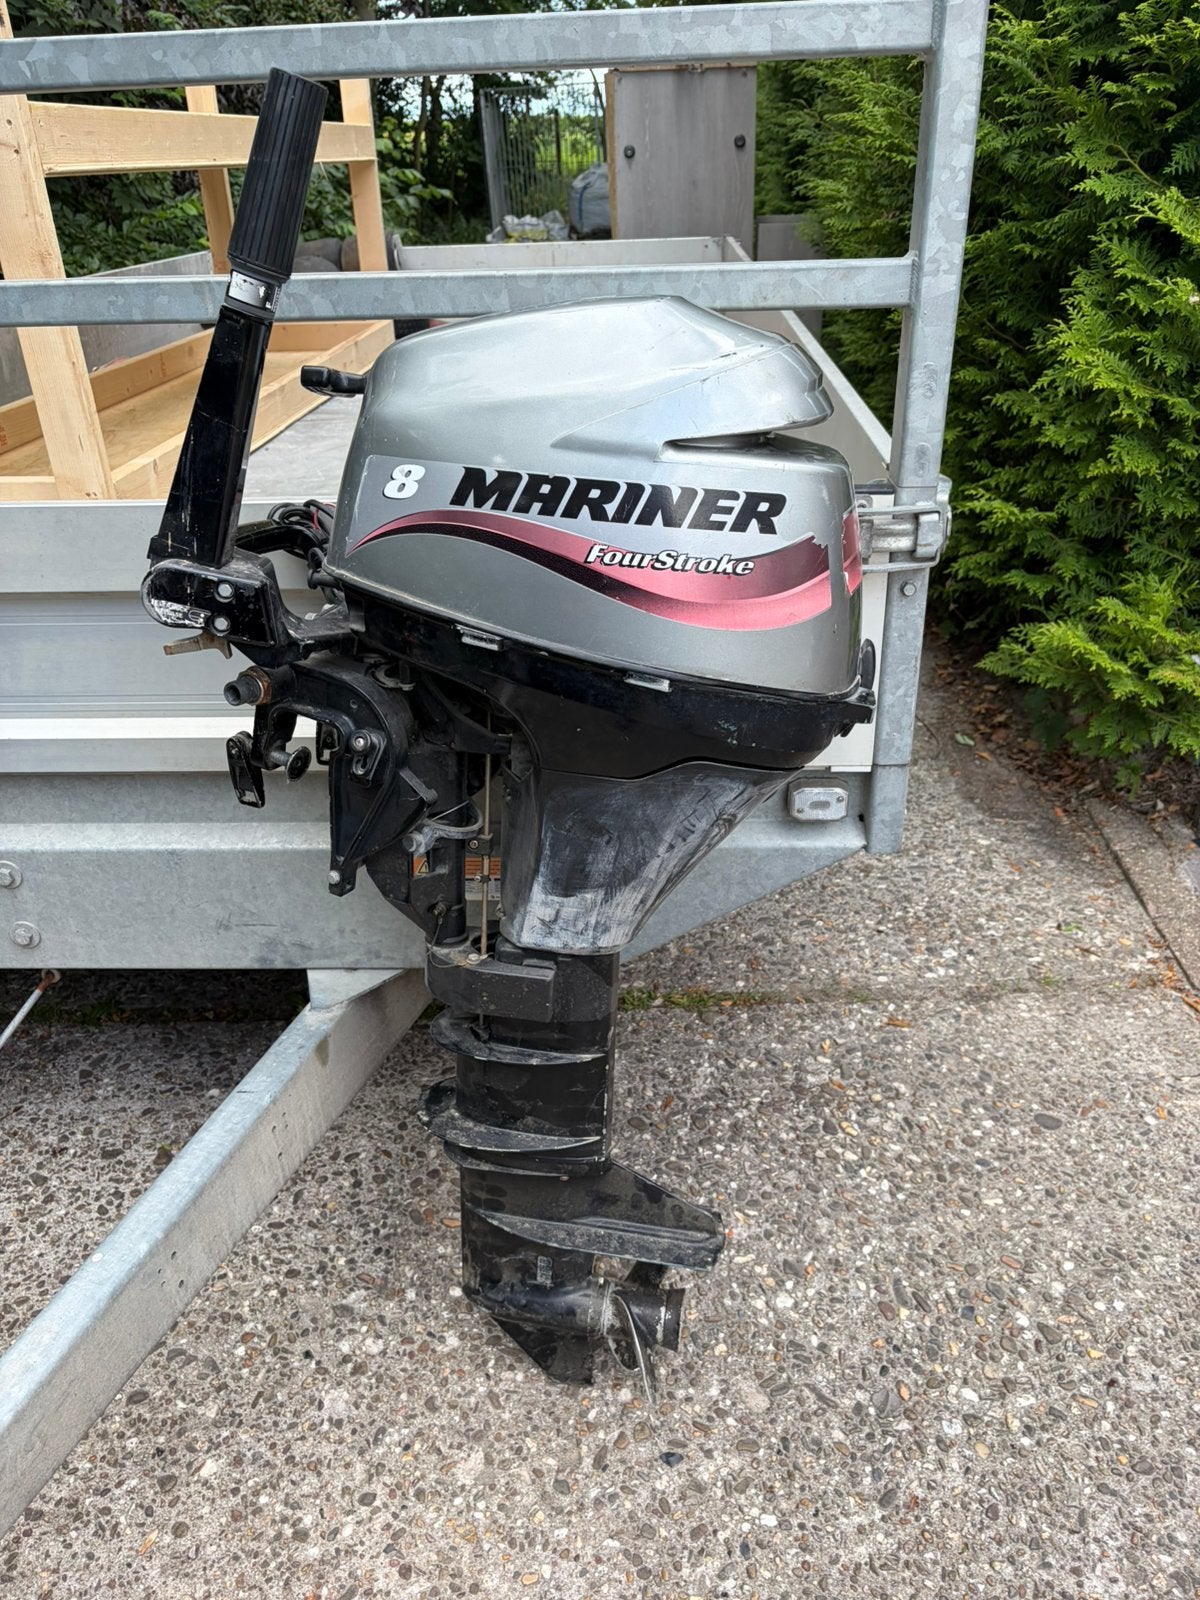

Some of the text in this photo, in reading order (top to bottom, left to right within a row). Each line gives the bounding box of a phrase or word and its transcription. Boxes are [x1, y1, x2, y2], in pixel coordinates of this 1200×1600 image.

[382, 464, 426, 500] 8
[449, 465, 787, 535] MARINER
[585, 543, 755, 576] FourStroke
